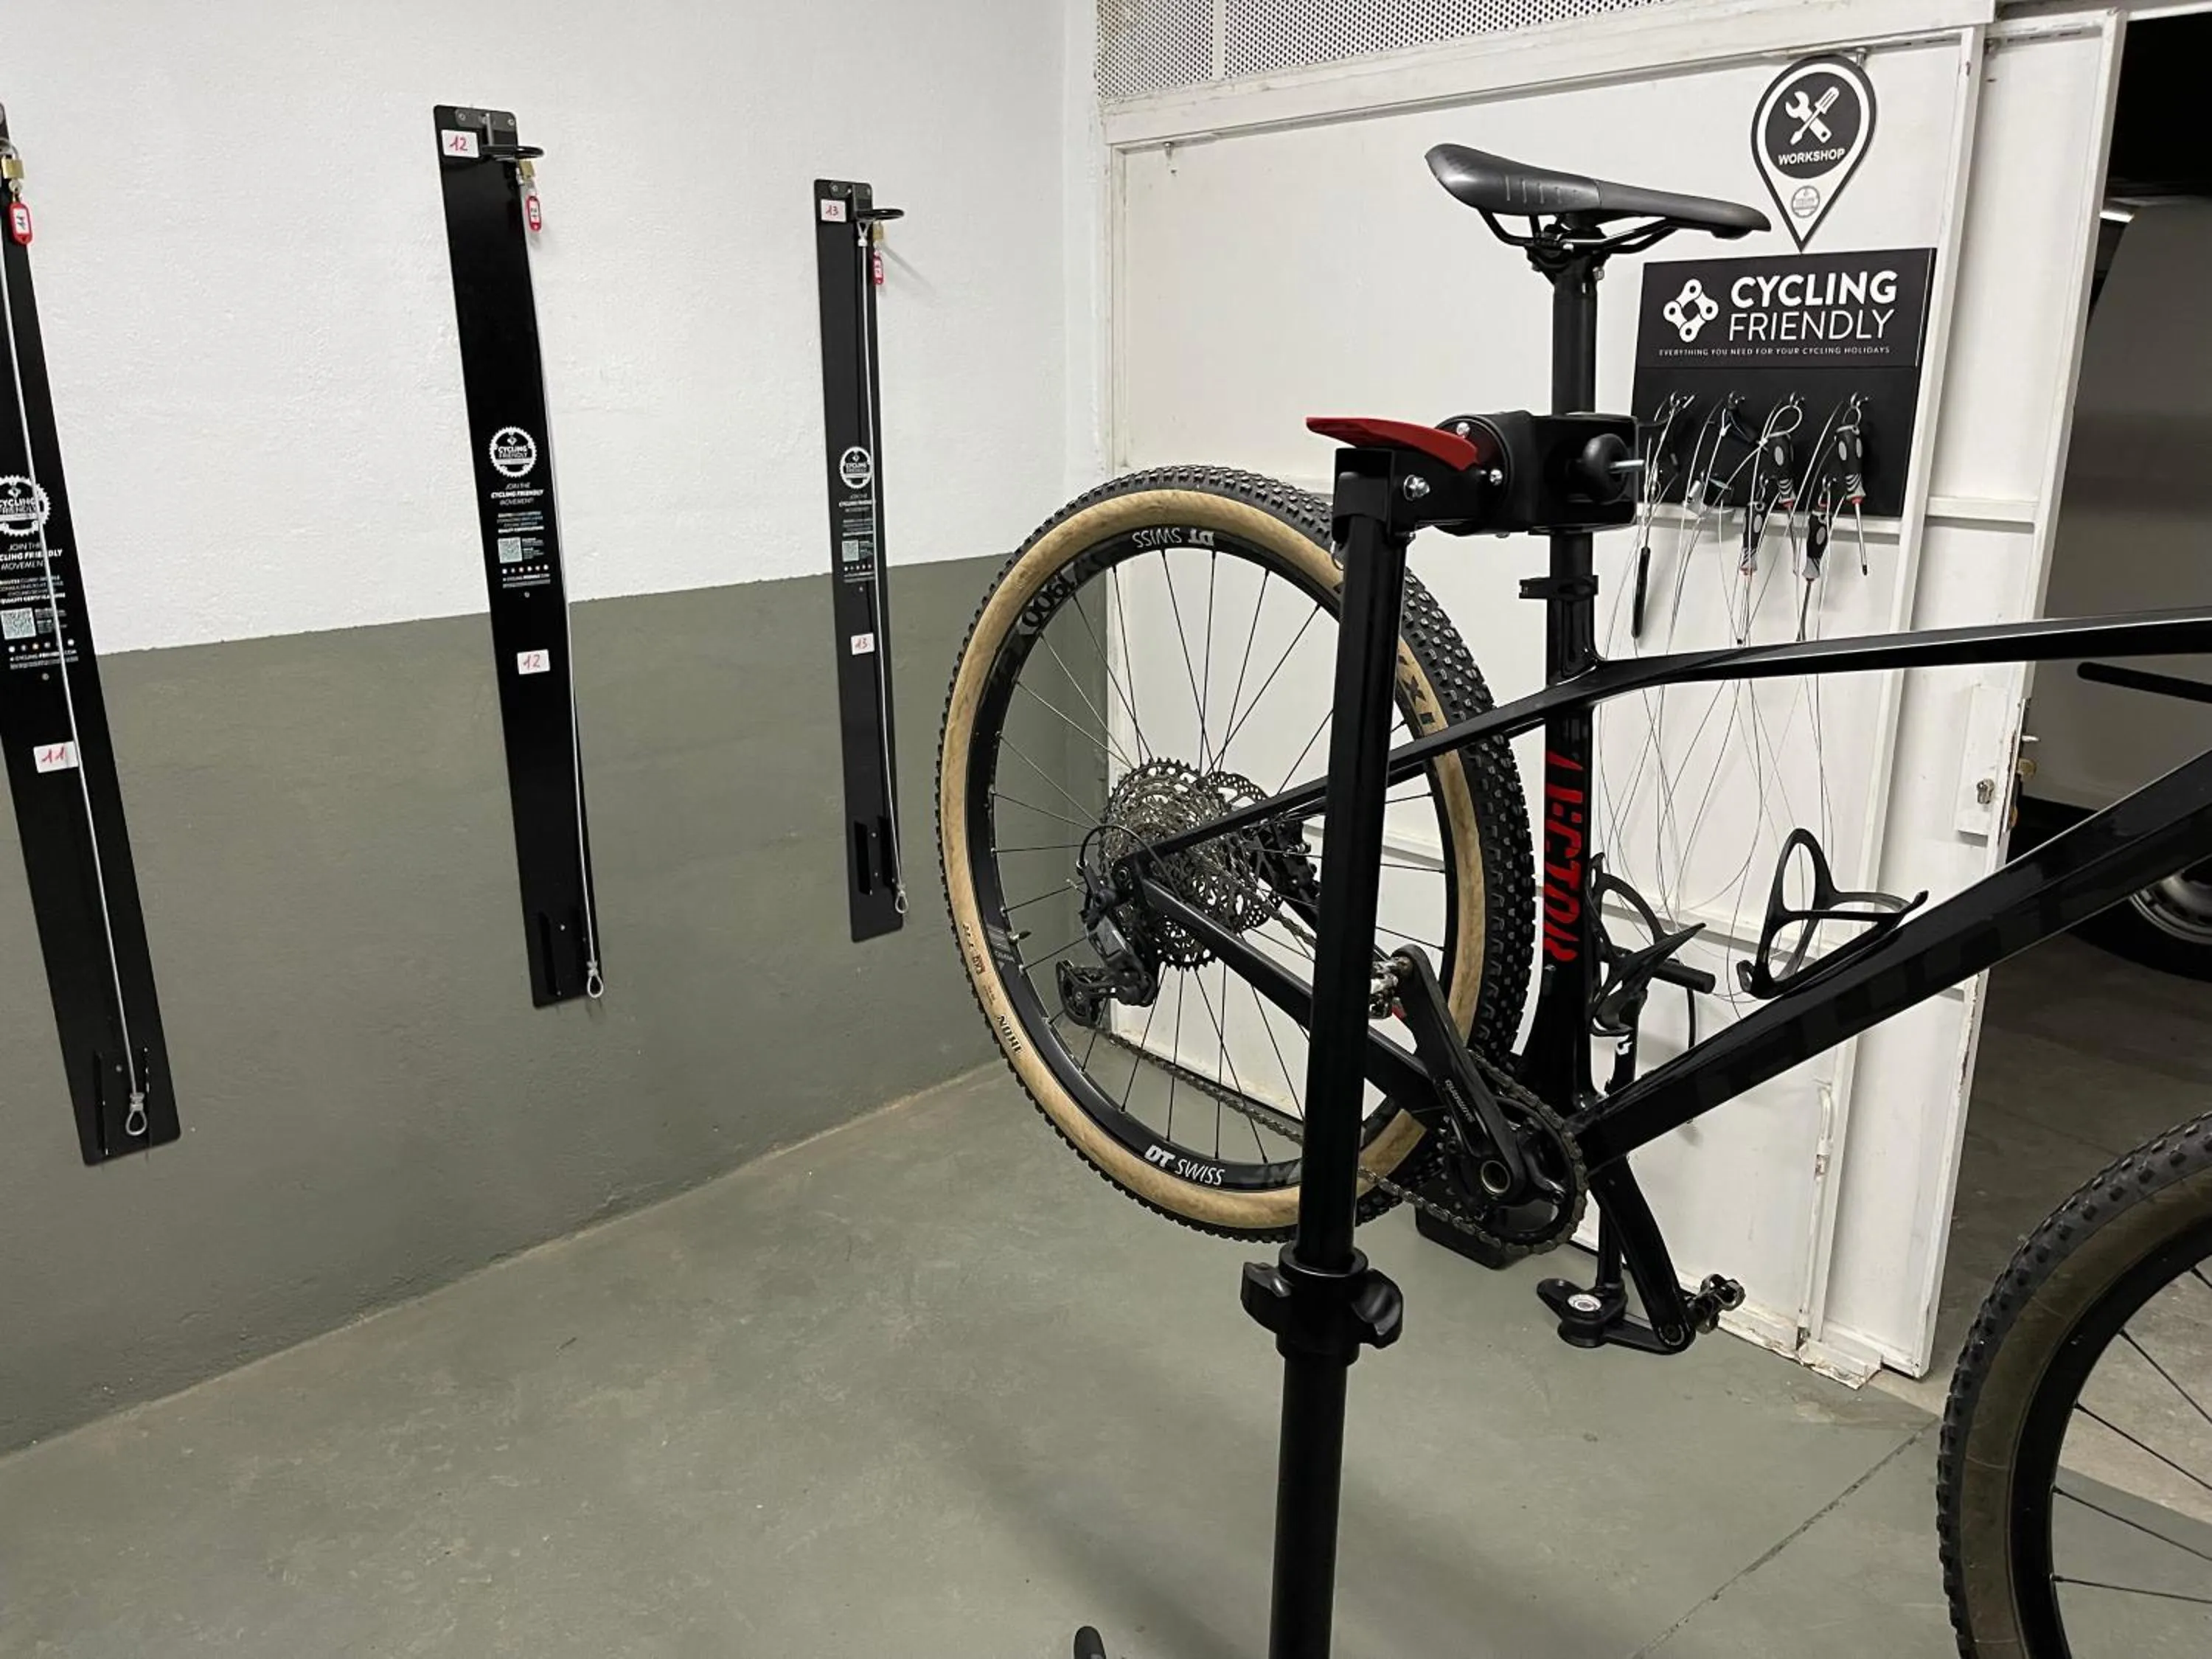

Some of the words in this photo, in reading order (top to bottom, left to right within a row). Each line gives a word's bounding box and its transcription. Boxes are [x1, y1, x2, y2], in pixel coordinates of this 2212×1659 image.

[449, 135, 468, 151] 12
[1778, 148, 1846, 166] WORKSHOP
[826, 204, 838, 216] 13
[1731, 270, 1899, 309] CYCLING
[1729, 308, 1895, 341] FRIENDLY
[1659, 348, 1708, 357] EVERYTHING
[1711, 348, 1728, 356] YOU
[1731, 347, 1753, 355] NEED
[1775, 347, 1800, 355] YOUR
[1802, 347, 1841, 355] CYCLING
[1844, 345, 1891, 354] HOLIDAYS
[1132, 527, 1182, 548] SWISS
[1188, 528, 1215, 546] DT
[24, 548, 63, 560] FRIEDLY
[1, 560, 47, 571] MOVEMEN
[523, 653, 540, 669] 12
[41, 746, 64, 763] 11
[1144, 1144, 1177, 1168] DT
[1174, 1158, 1225, 1186] SWISS
